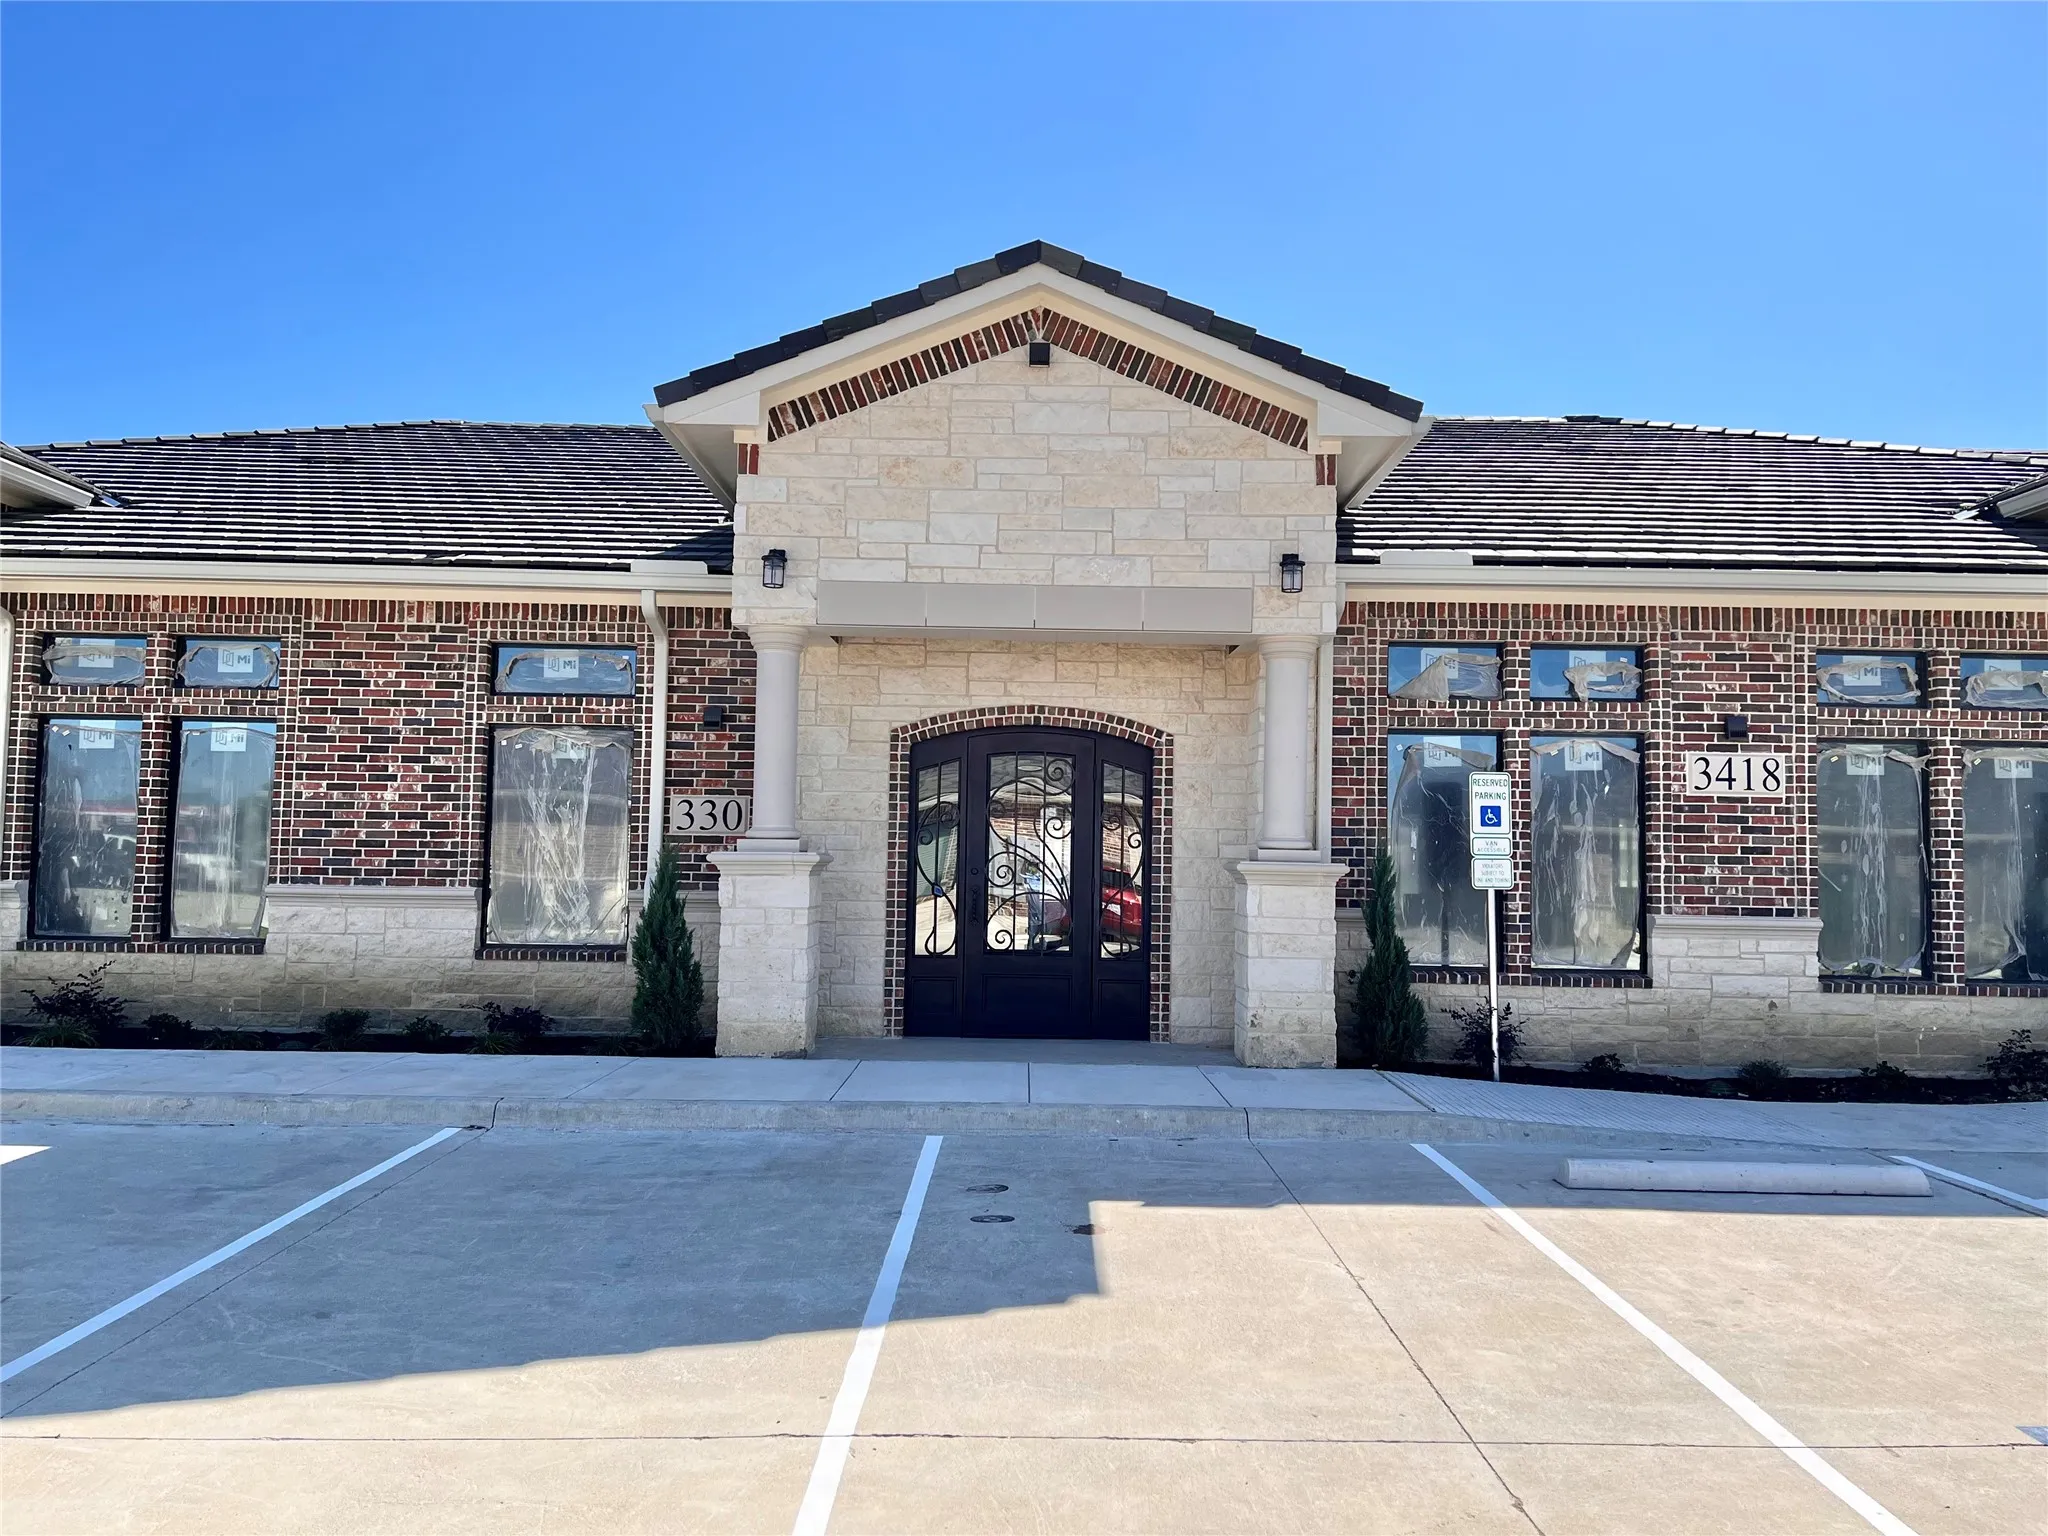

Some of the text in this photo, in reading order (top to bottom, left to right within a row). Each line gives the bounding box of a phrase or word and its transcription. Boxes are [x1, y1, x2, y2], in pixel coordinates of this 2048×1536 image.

[237, 655, 251, 664] Mi
[563, 660, 577, 669] Mi
[1864, 667, 1879, 676] Mi
[1585, 751, 1600, 761] Mi
[1694, 756, 1780, 792] 3418
[1472, 778, 1508, 788] RESERVED
[1474, 791, 1507, 800] PARKING
[676, 799, 742, 831] 330
